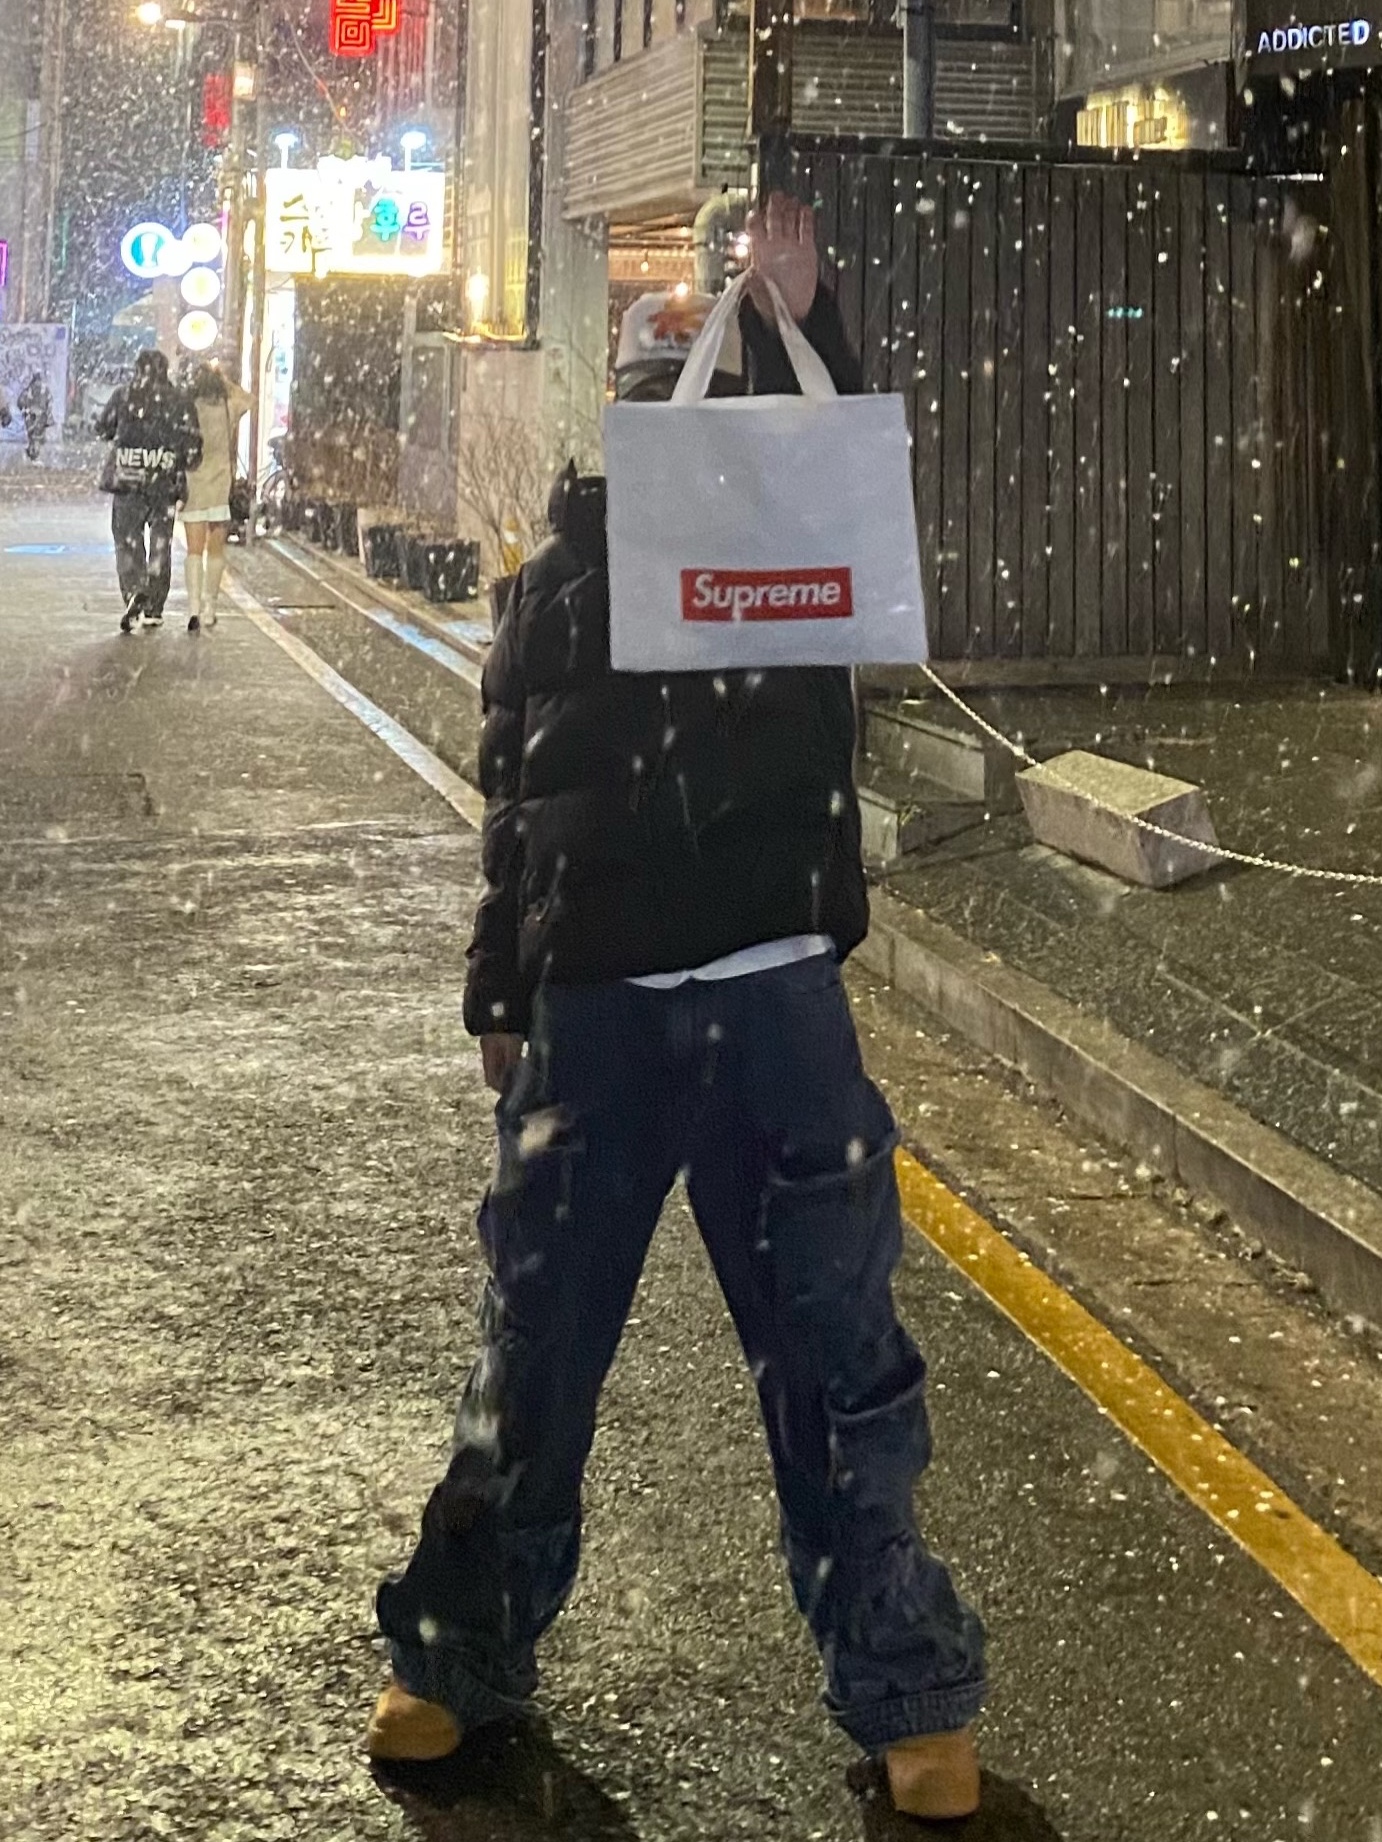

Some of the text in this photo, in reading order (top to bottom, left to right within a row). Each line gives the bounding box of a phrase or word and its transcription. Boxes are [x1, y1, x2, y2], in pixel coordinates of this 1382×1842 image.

[1257, 19, 1370, 54] ADDICTED
[116, 446, 176, 469] NEWS
[692, 573, 841, 623] Supreme
